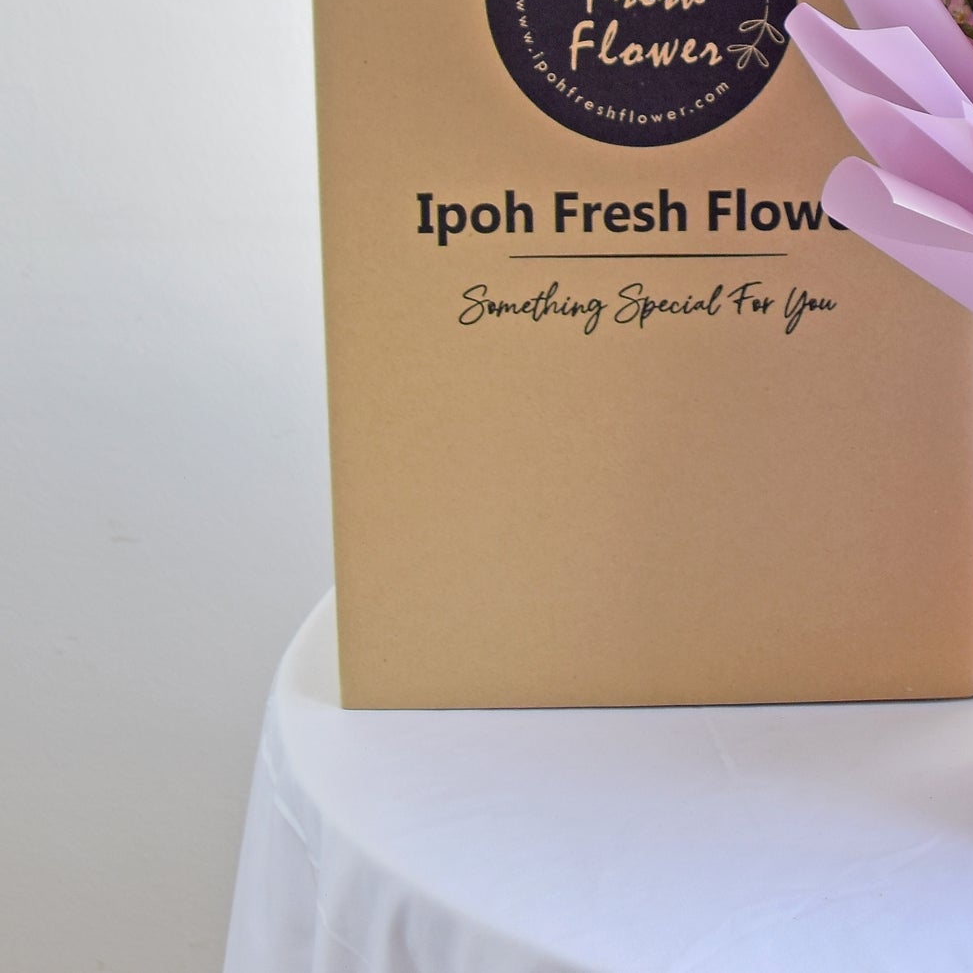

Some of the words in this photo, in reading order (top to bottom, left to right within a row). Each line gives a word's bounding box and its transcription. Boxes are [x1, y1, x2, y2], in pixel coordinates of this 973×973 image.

[569, 19, 723, 71] Flower
[416, 189, 534, 246] Ipoh
[554, 188, 688, 233] Fresh
[458, 281, 608, 335] Something
[614, 282, 723, 329] Special
[727, 281, 776, 316] For
[784, 286, 837, 334] You
